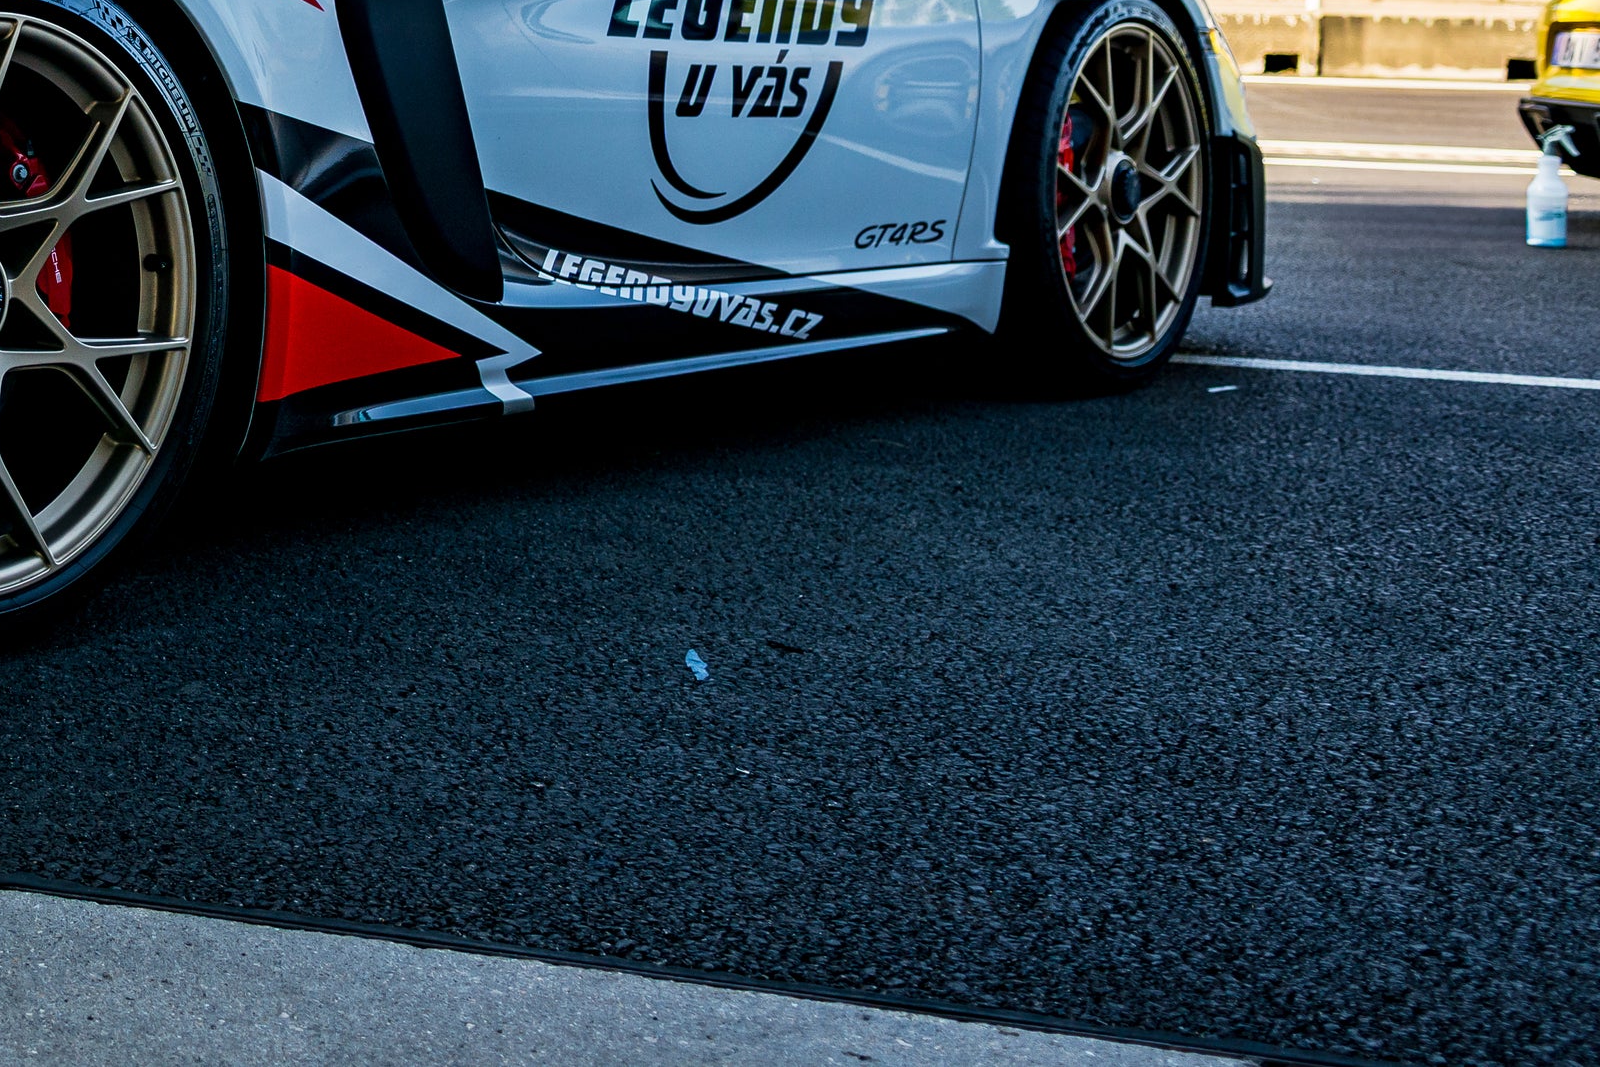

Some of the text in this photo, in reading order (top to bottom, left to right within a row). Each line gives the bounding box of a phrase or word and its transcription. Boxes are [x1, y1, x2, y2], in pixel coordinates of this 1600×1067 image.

[142, 46, 196, 130] MICHELIN
[675, 63, 718, 118] U
[854, 219, 947, 250] GT4RS
